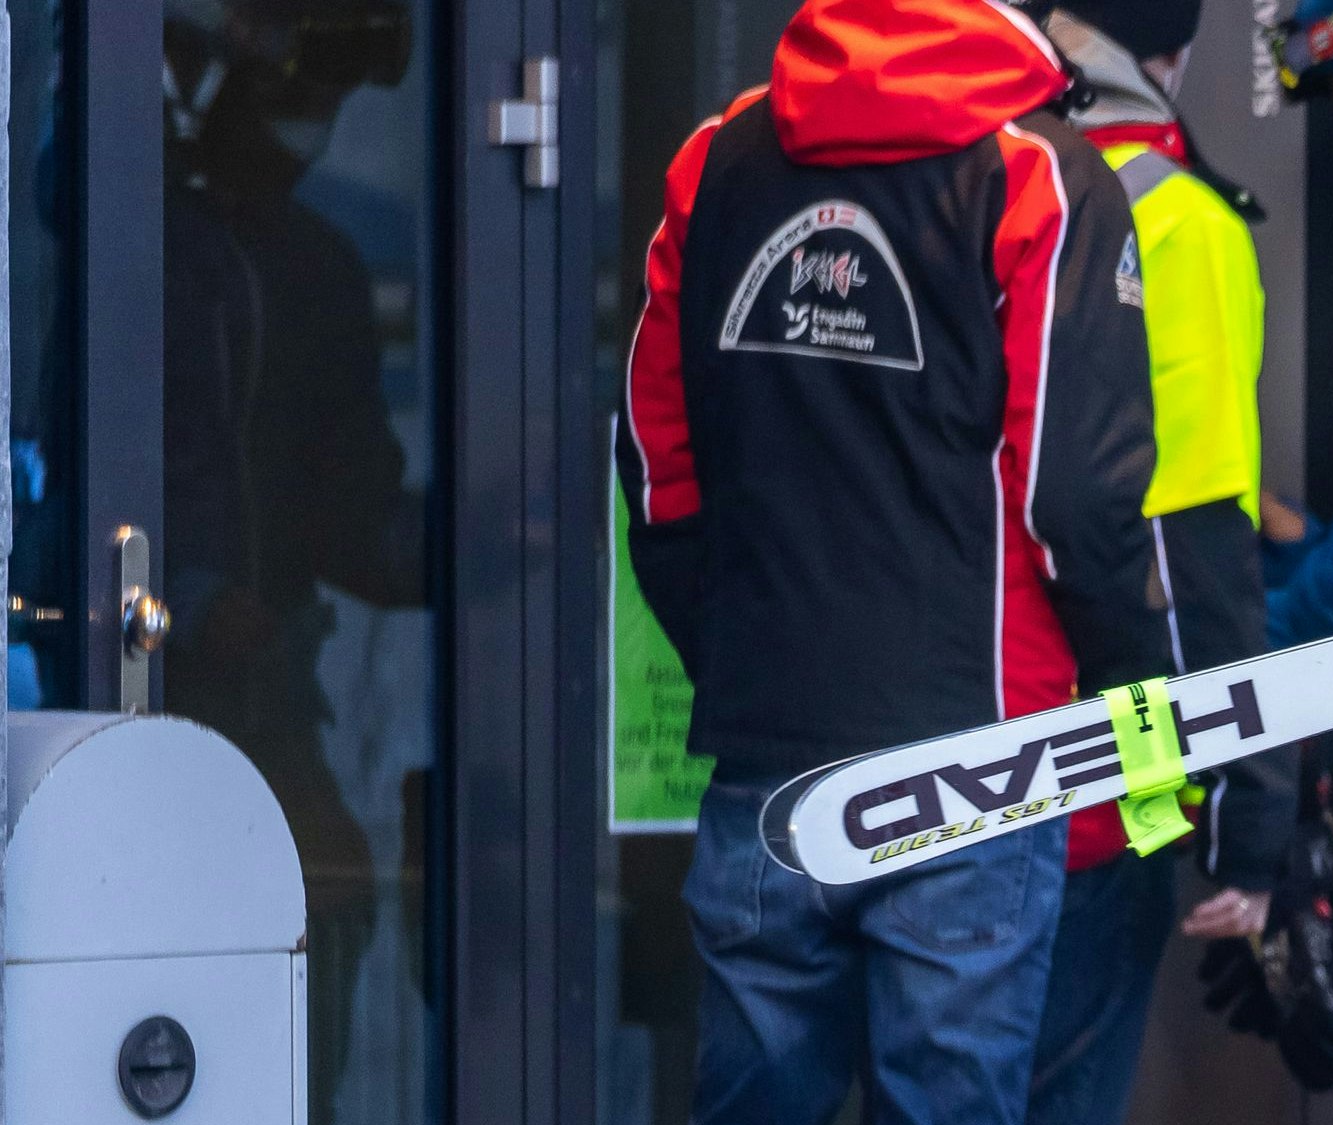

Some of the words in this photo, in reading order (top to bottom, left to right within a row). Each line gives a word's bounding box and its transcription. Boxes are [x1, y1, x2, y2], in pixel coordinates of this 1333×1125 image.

[766, 217, 811, 261] Arena
[843, 679, 1265, 850] HEAD
[870, 816, 987, 864] TEAM
